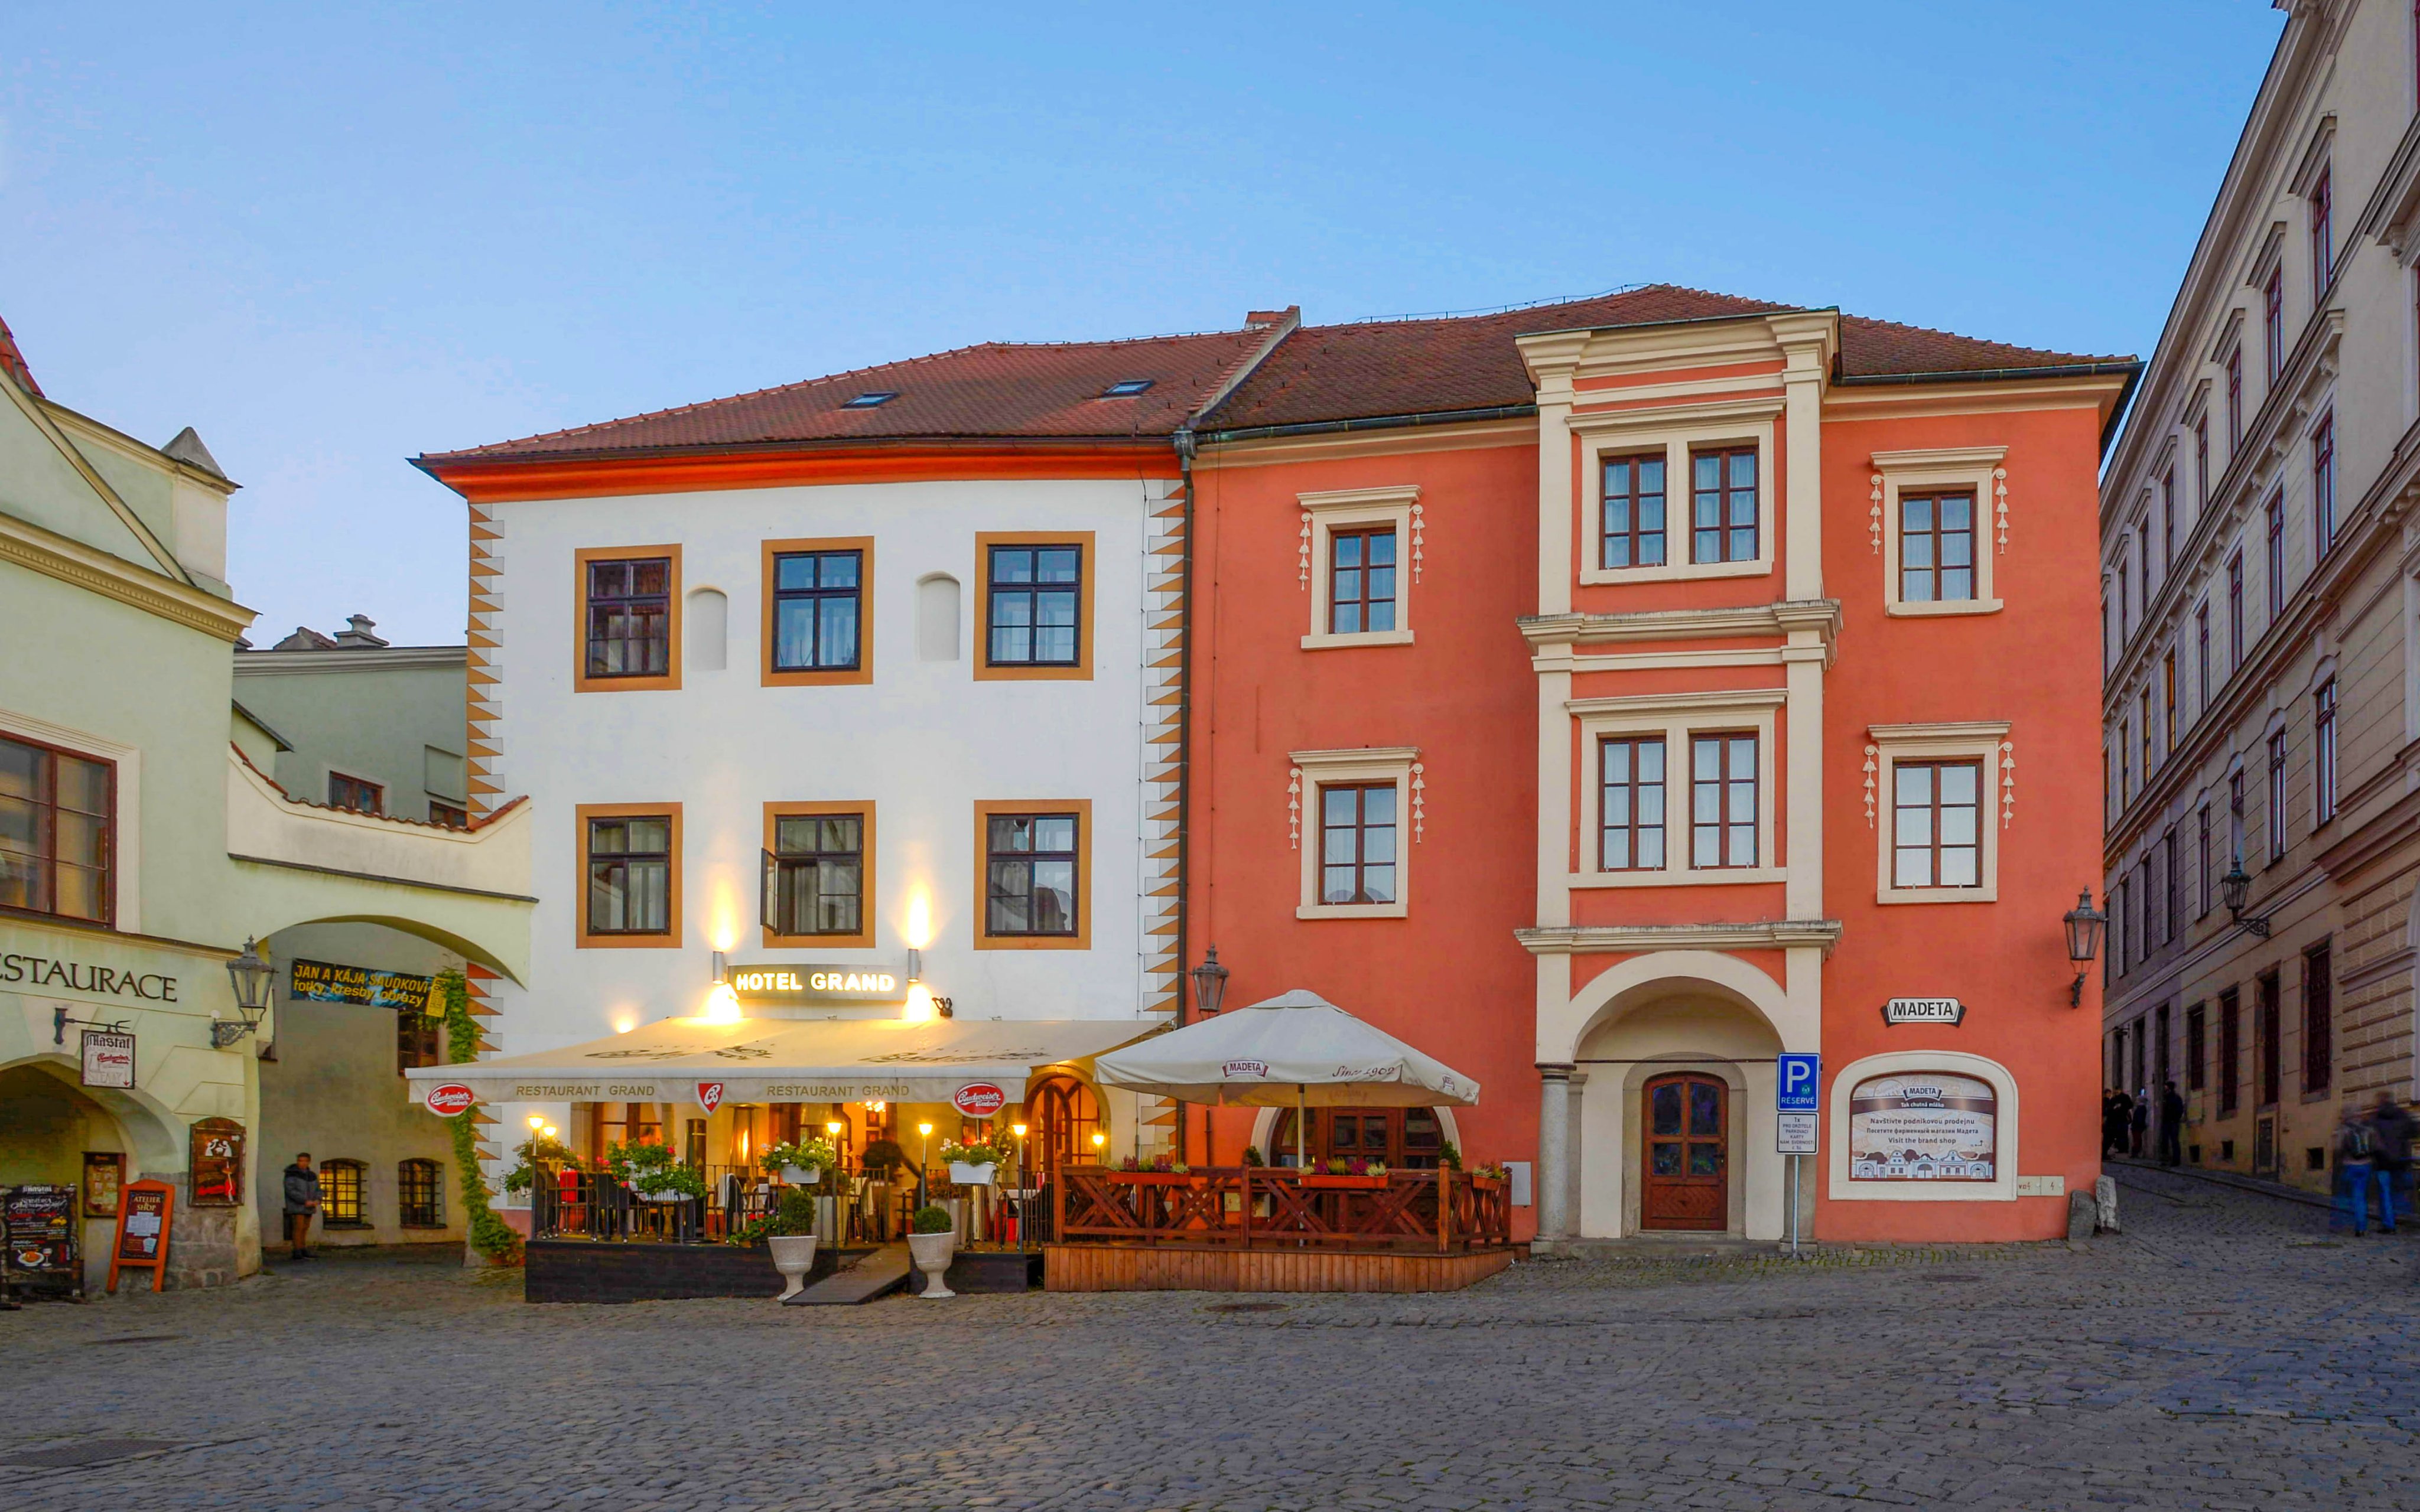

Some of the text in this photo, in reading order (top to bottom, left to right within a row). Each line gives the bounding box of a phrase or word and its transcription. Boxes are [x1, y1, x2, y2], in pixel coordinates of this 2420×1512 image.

[0, 953, 177, 1002] STAURACE
[295, 965, 320, 979] JAN
[322, 968, 330, 980] A
[736, 973, 895, 992] HOTEL GRAND
[1894, 1002, 1953, 1016] MADETA
[1787, 1061, 1810, 1093] P
[516, 1086, 655, 1096] RESTAURANT GRAND
[767, 1086, 909, 1096] RESTAURANT GRAND
[958, 1091, 1001, 1106] Budweiser
